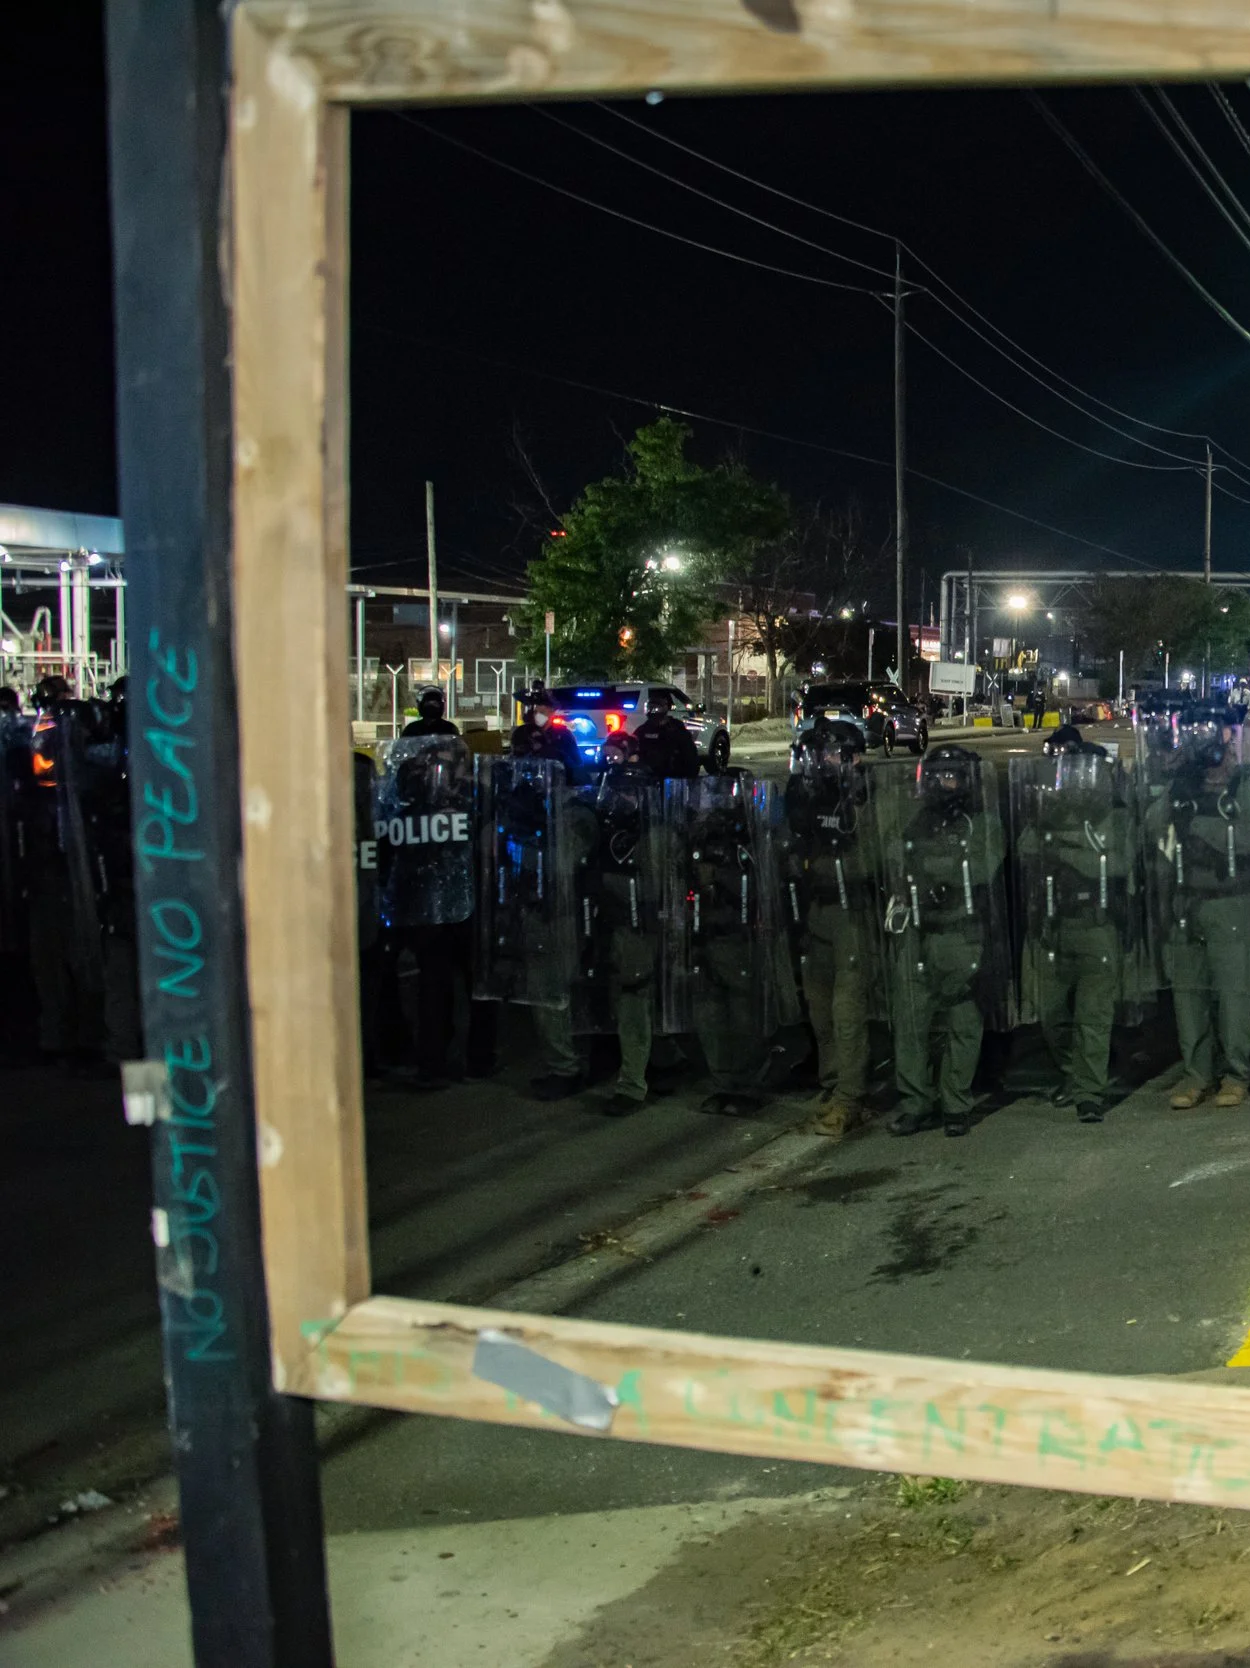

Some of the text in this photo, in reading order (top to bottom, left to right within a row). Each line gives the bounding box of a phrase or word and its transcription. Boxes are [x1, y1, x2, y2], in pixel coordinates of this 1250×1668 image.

[137, 627, 236, 1362] NO JUSTICE NO PEACE
[373, 813, 469, 846] POLICE
